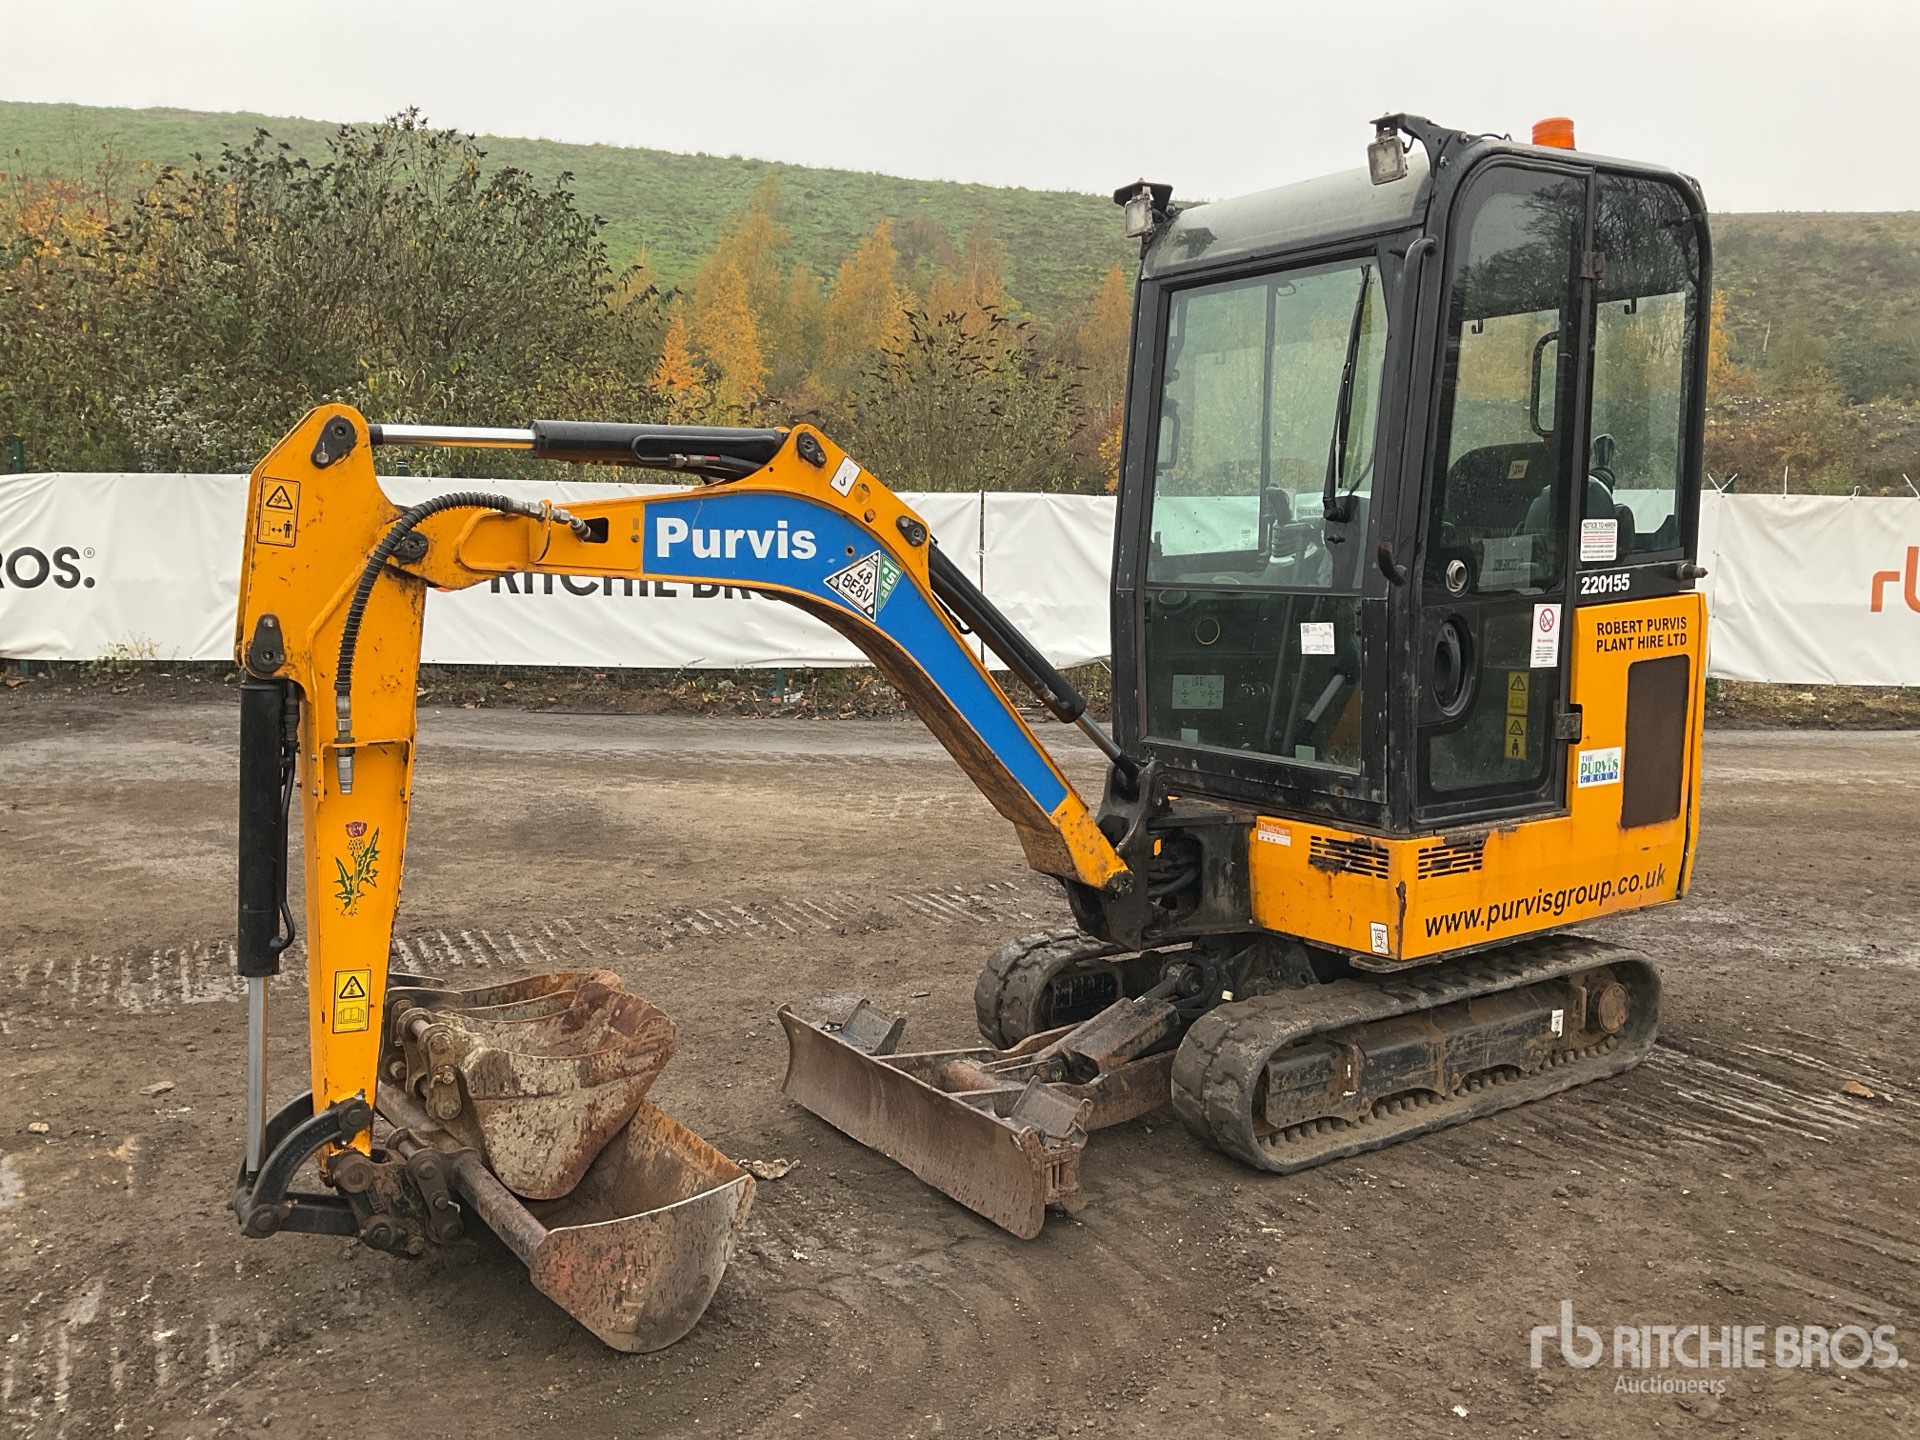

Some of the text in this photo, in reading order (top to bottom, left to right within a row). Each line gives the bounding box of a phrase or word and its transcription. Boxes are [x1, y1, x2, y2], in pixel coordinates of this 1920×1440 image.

[656, 517, 817, 560] Purvis
[0, 546, 96, 590] OS.
[857, 568, 873, 585] 48
[841, 573, 873, 603] BE8V
[1580, 573, 1630, 595] 220155
[1597, 616, 1687, 636] ROBERT PURVIS
[1596, 632, 1687, 653] PLANT HIRE LTD
[1581, 755, 1593, 763] THE
[1581, 758, 1619, 775] PURVIS
[1581, 771, 1617, 783] GROUP
[1259, 821, 1291, 837] Thatcham
[1425, 862, 1667, 938] www.purvisgroup.co.uk
